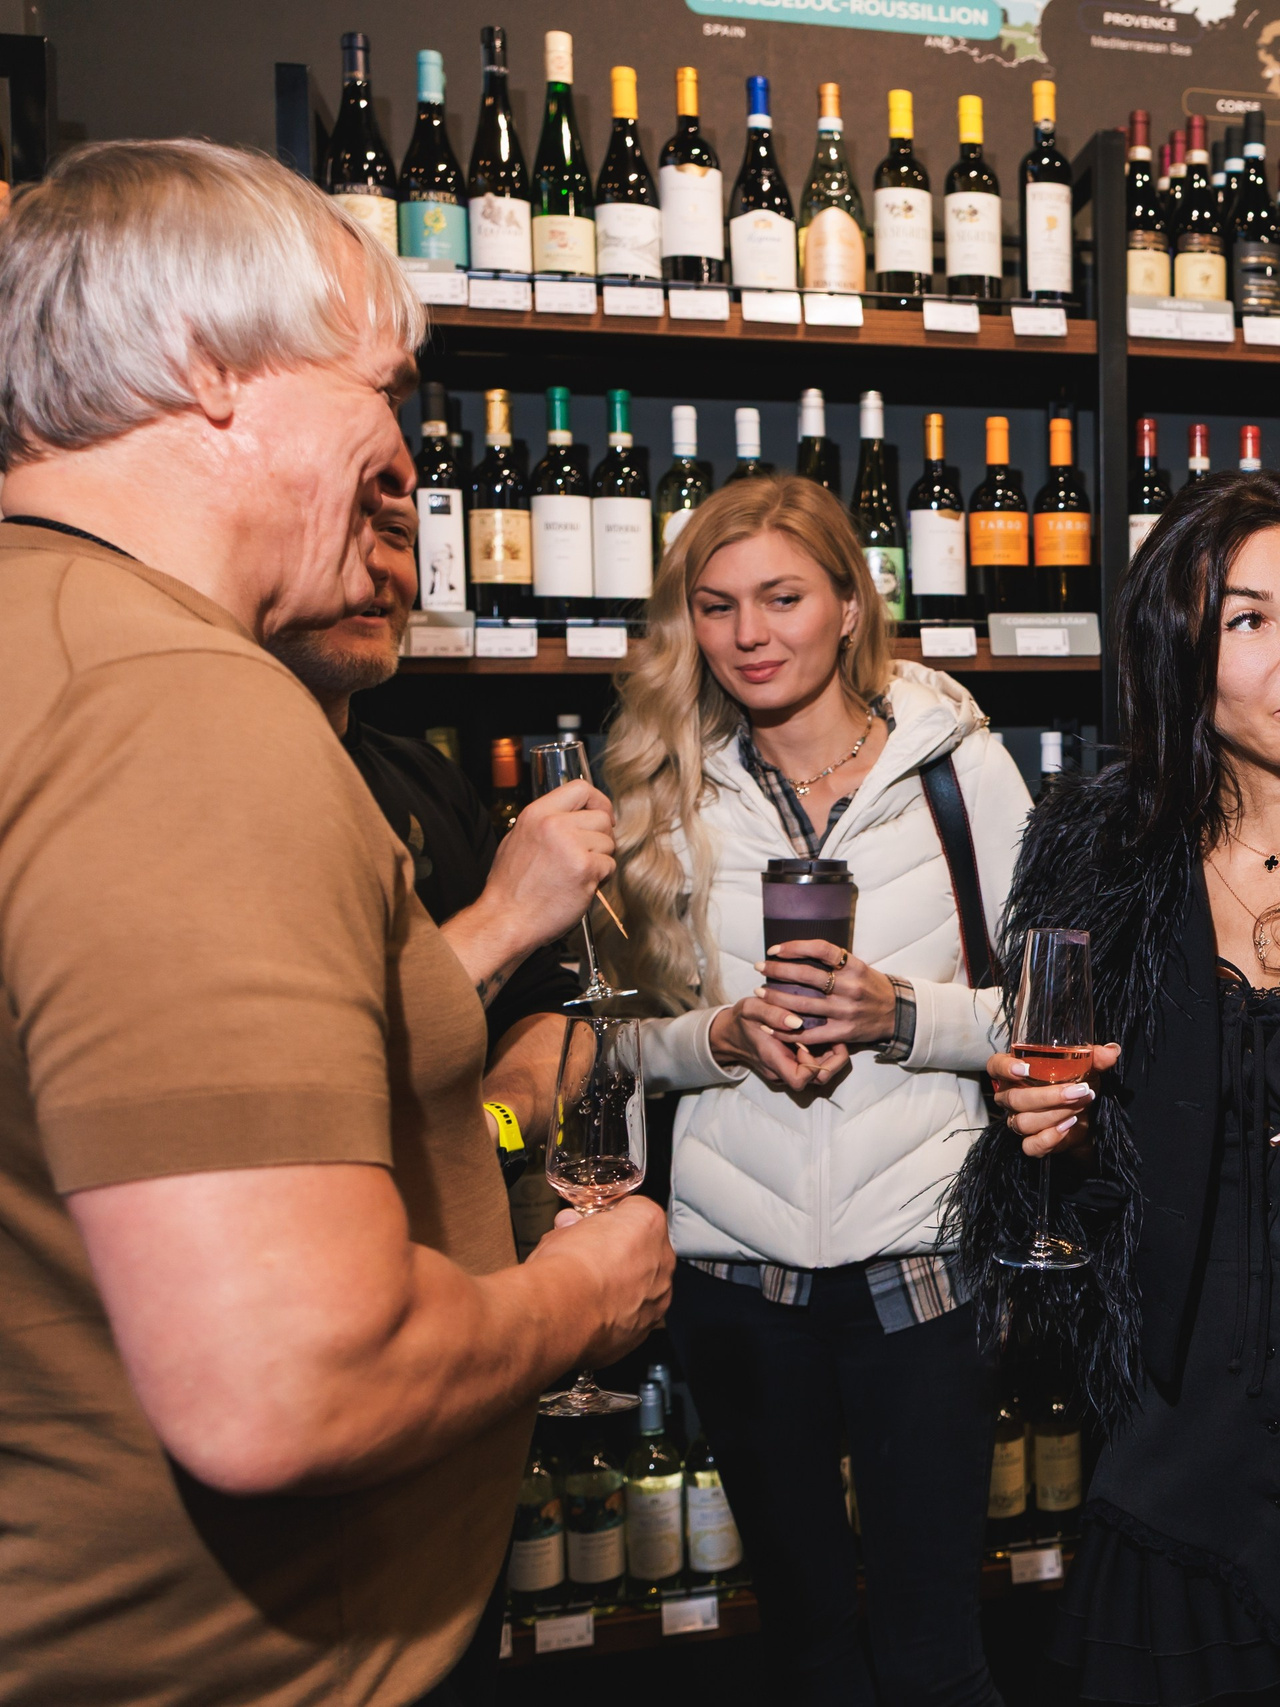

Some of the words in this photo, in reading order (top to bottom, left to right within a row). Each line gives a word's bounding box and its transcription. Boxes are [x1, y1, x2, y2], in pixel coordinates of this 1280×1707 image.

[1103, 11, 1177, 32] PROVENCE
[702, 22, 746, 38] SPAIN
[1170, 42, 1192, 56] Sea
[1216, 98, 1261, 113] CORSE
